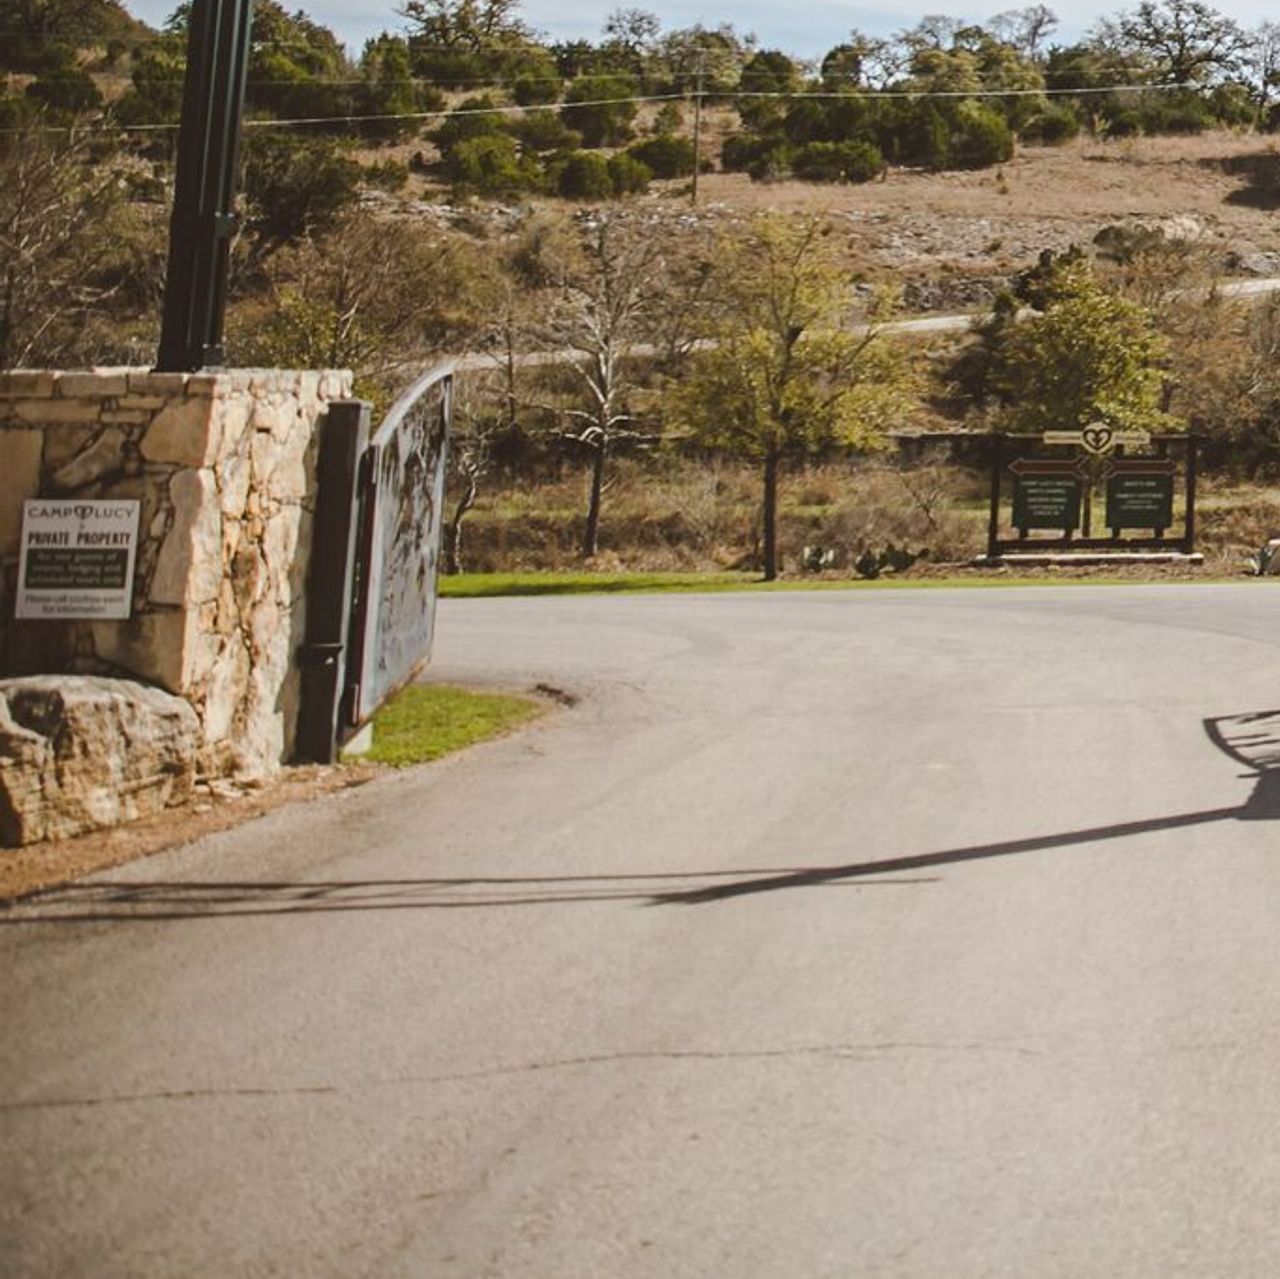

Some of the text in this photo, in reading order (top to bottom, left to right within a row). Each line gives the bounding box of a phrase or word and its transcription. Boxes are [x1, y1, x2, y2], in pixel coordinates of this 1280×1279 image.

[28, 506, 133, 518] CAMP LUCY
[28, 531, 130, 545] PRIVATE PROPERTY
